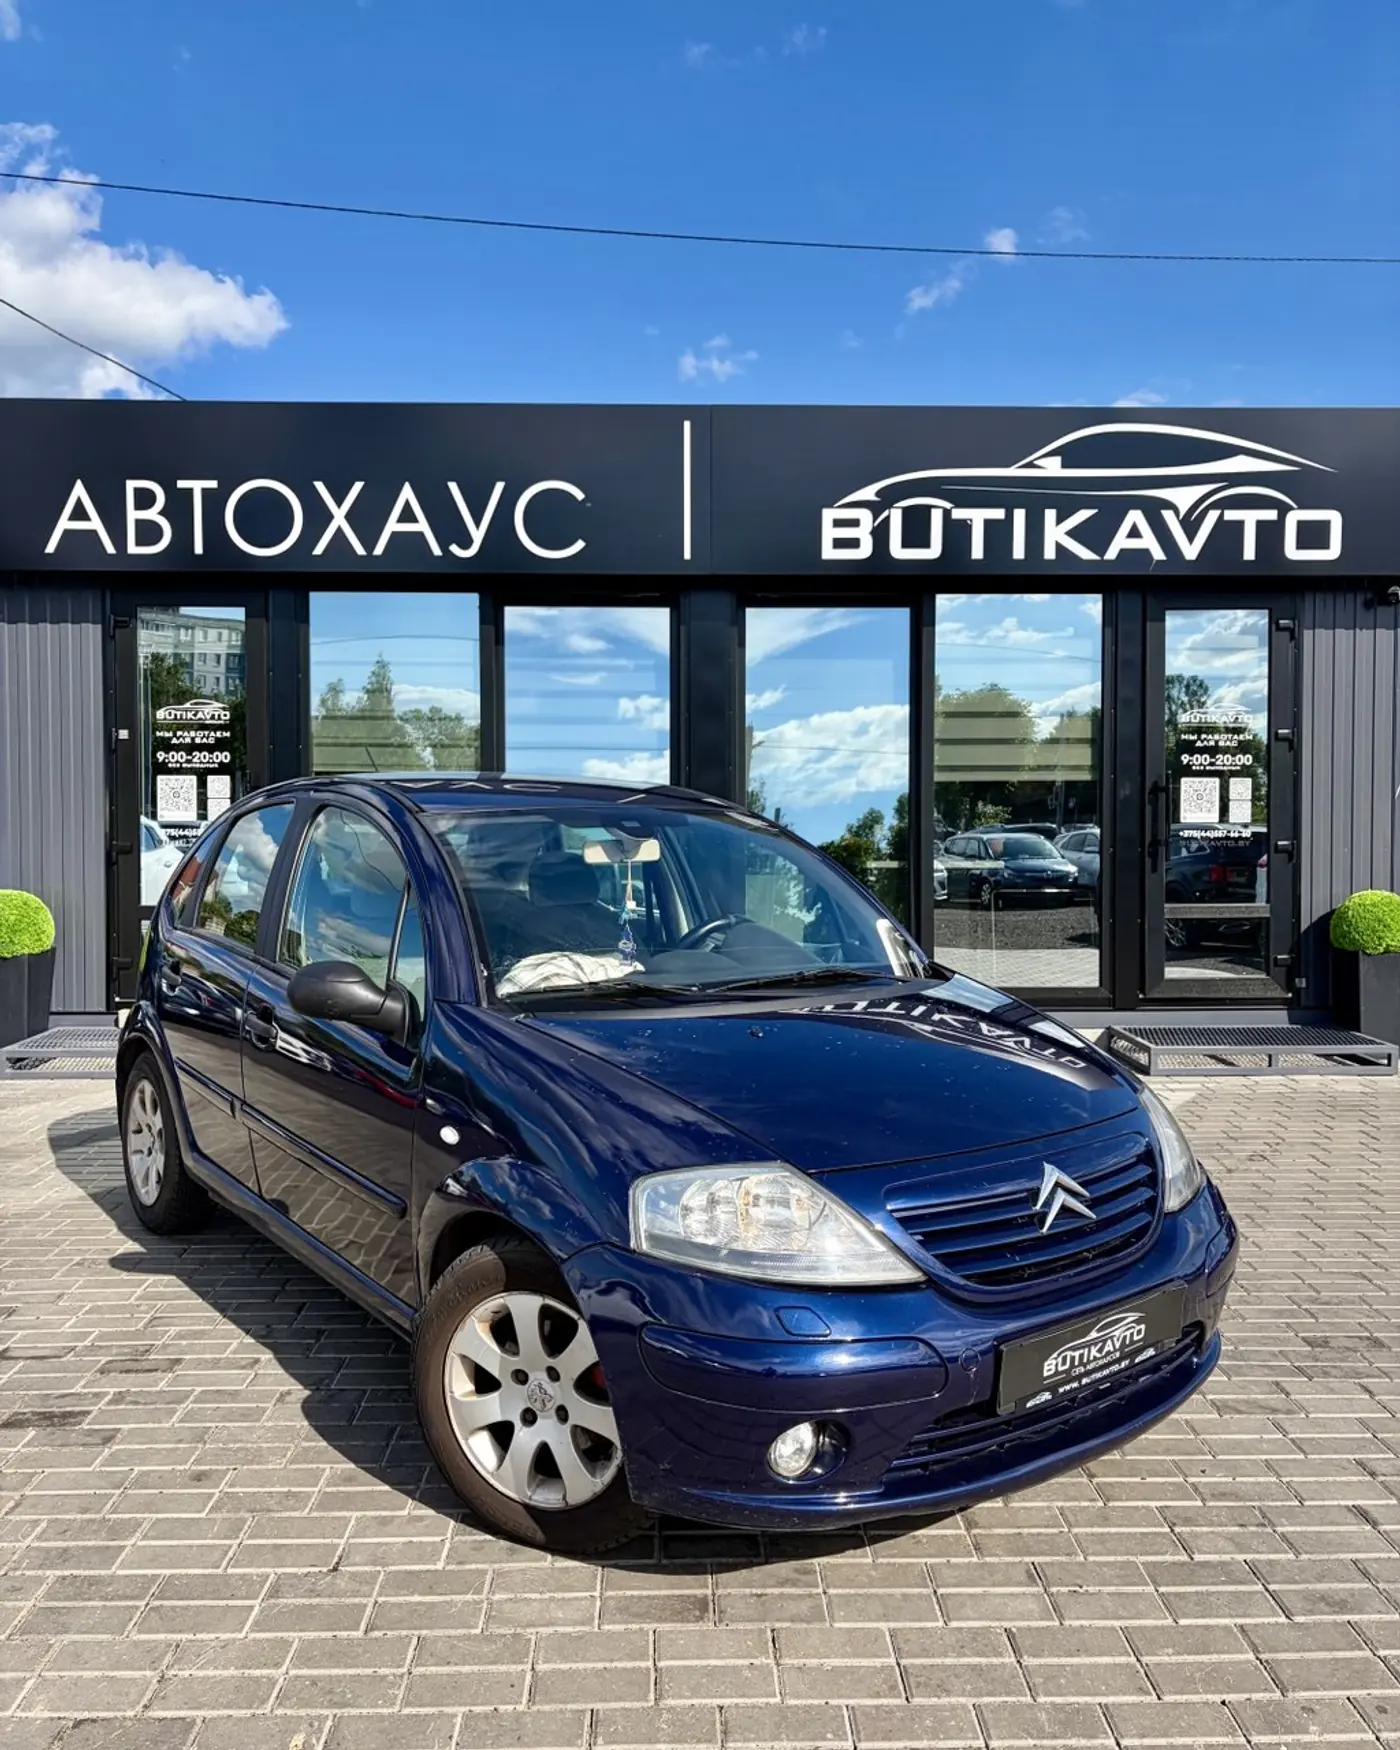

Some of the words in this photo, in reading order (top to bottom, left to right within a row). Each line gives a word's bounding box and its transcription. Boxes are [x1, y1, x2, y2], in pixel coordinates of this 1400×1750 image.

[44, 478, 587, 559] АВТОХАУС
[821, 507, 1342, 561] BUTIKAVTO
[156, 710, 231, 720] BUTIKAVTO
[156, 751, 231, 763] 9:00-20:00
[1181, 754, 1253, 765] 9:00-20:00
[1043, 1324, 1146, 1377] BUTIKAVTO
